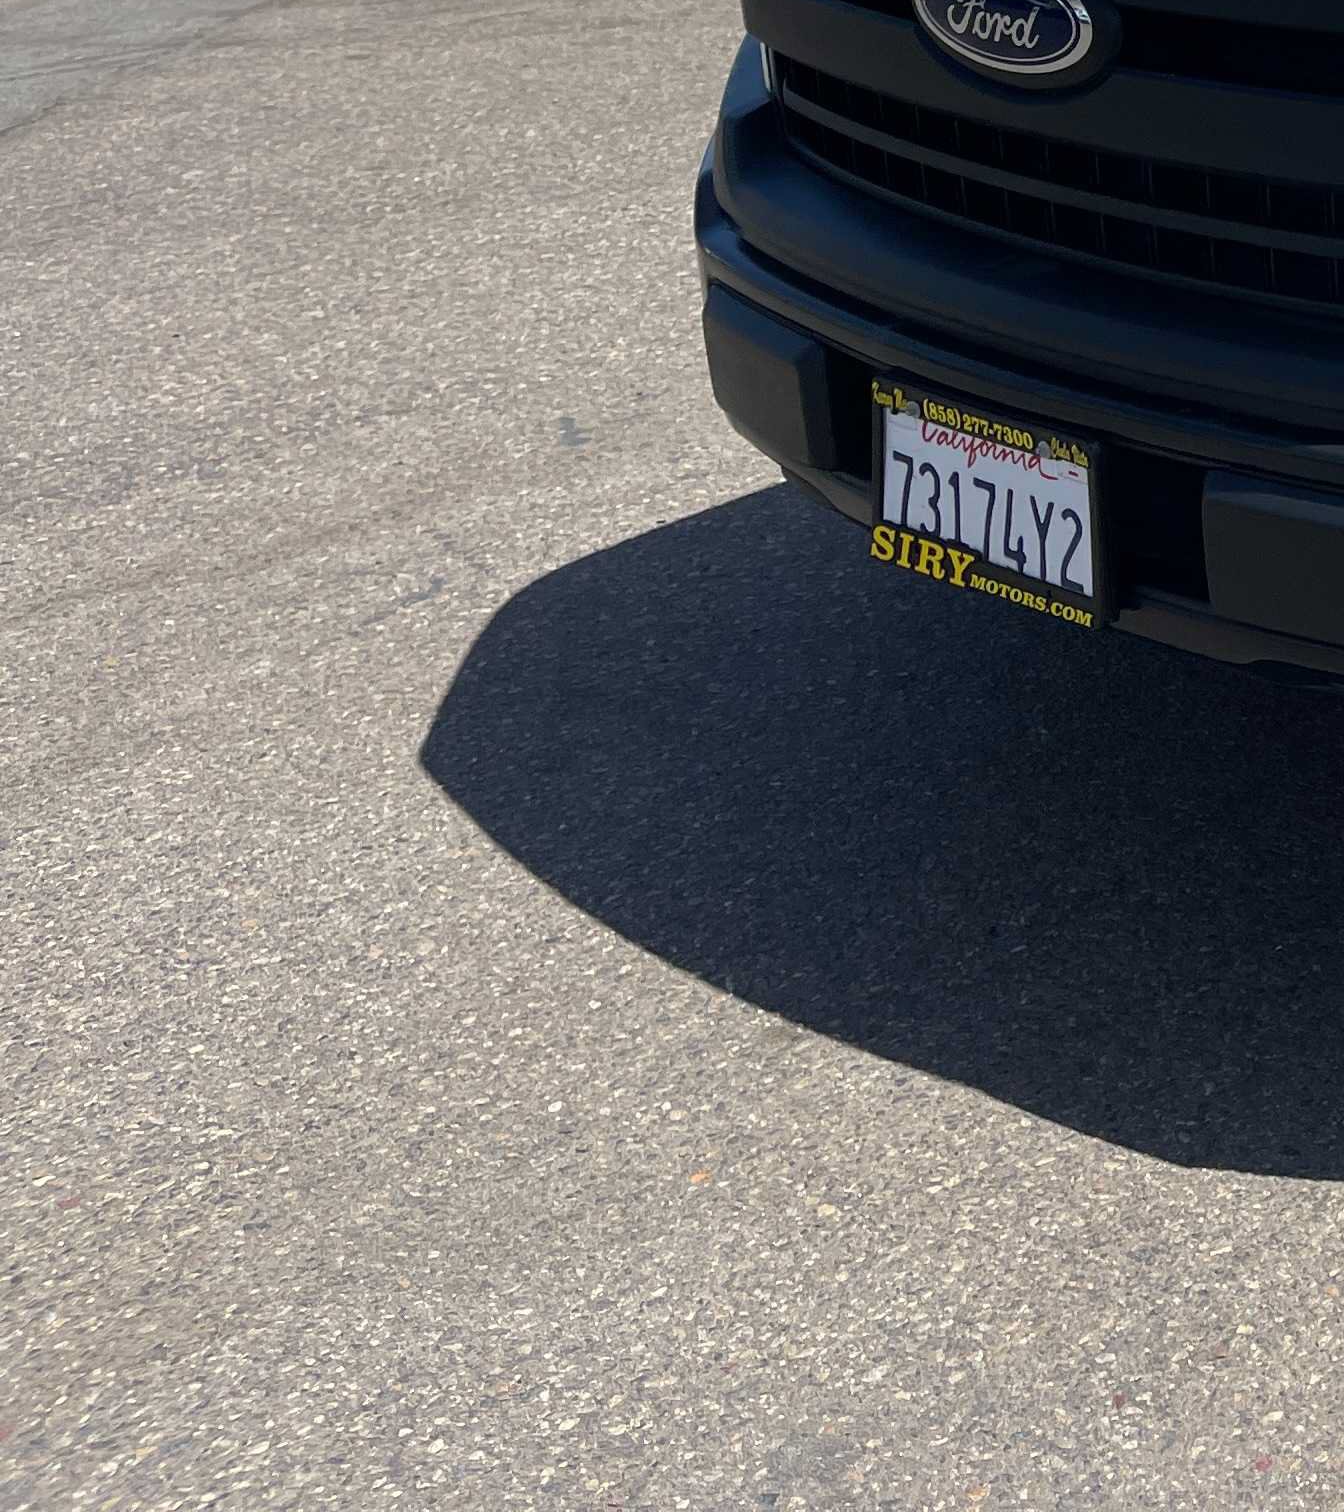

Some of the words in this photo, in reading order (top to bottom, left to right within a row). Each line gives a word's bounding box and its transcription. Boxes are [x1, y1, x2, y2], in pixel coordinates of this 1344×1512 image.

[920, 420, 1058, 480] California
[922, 398, 961, 430] (858)
[962, 413, 1034, 450] 277-7300
[892, 450, 1085, 593] 73174Y2
[870, 525, 976, 588] SIRY
[970, 573, 1094, 629] MOTORS.COM
